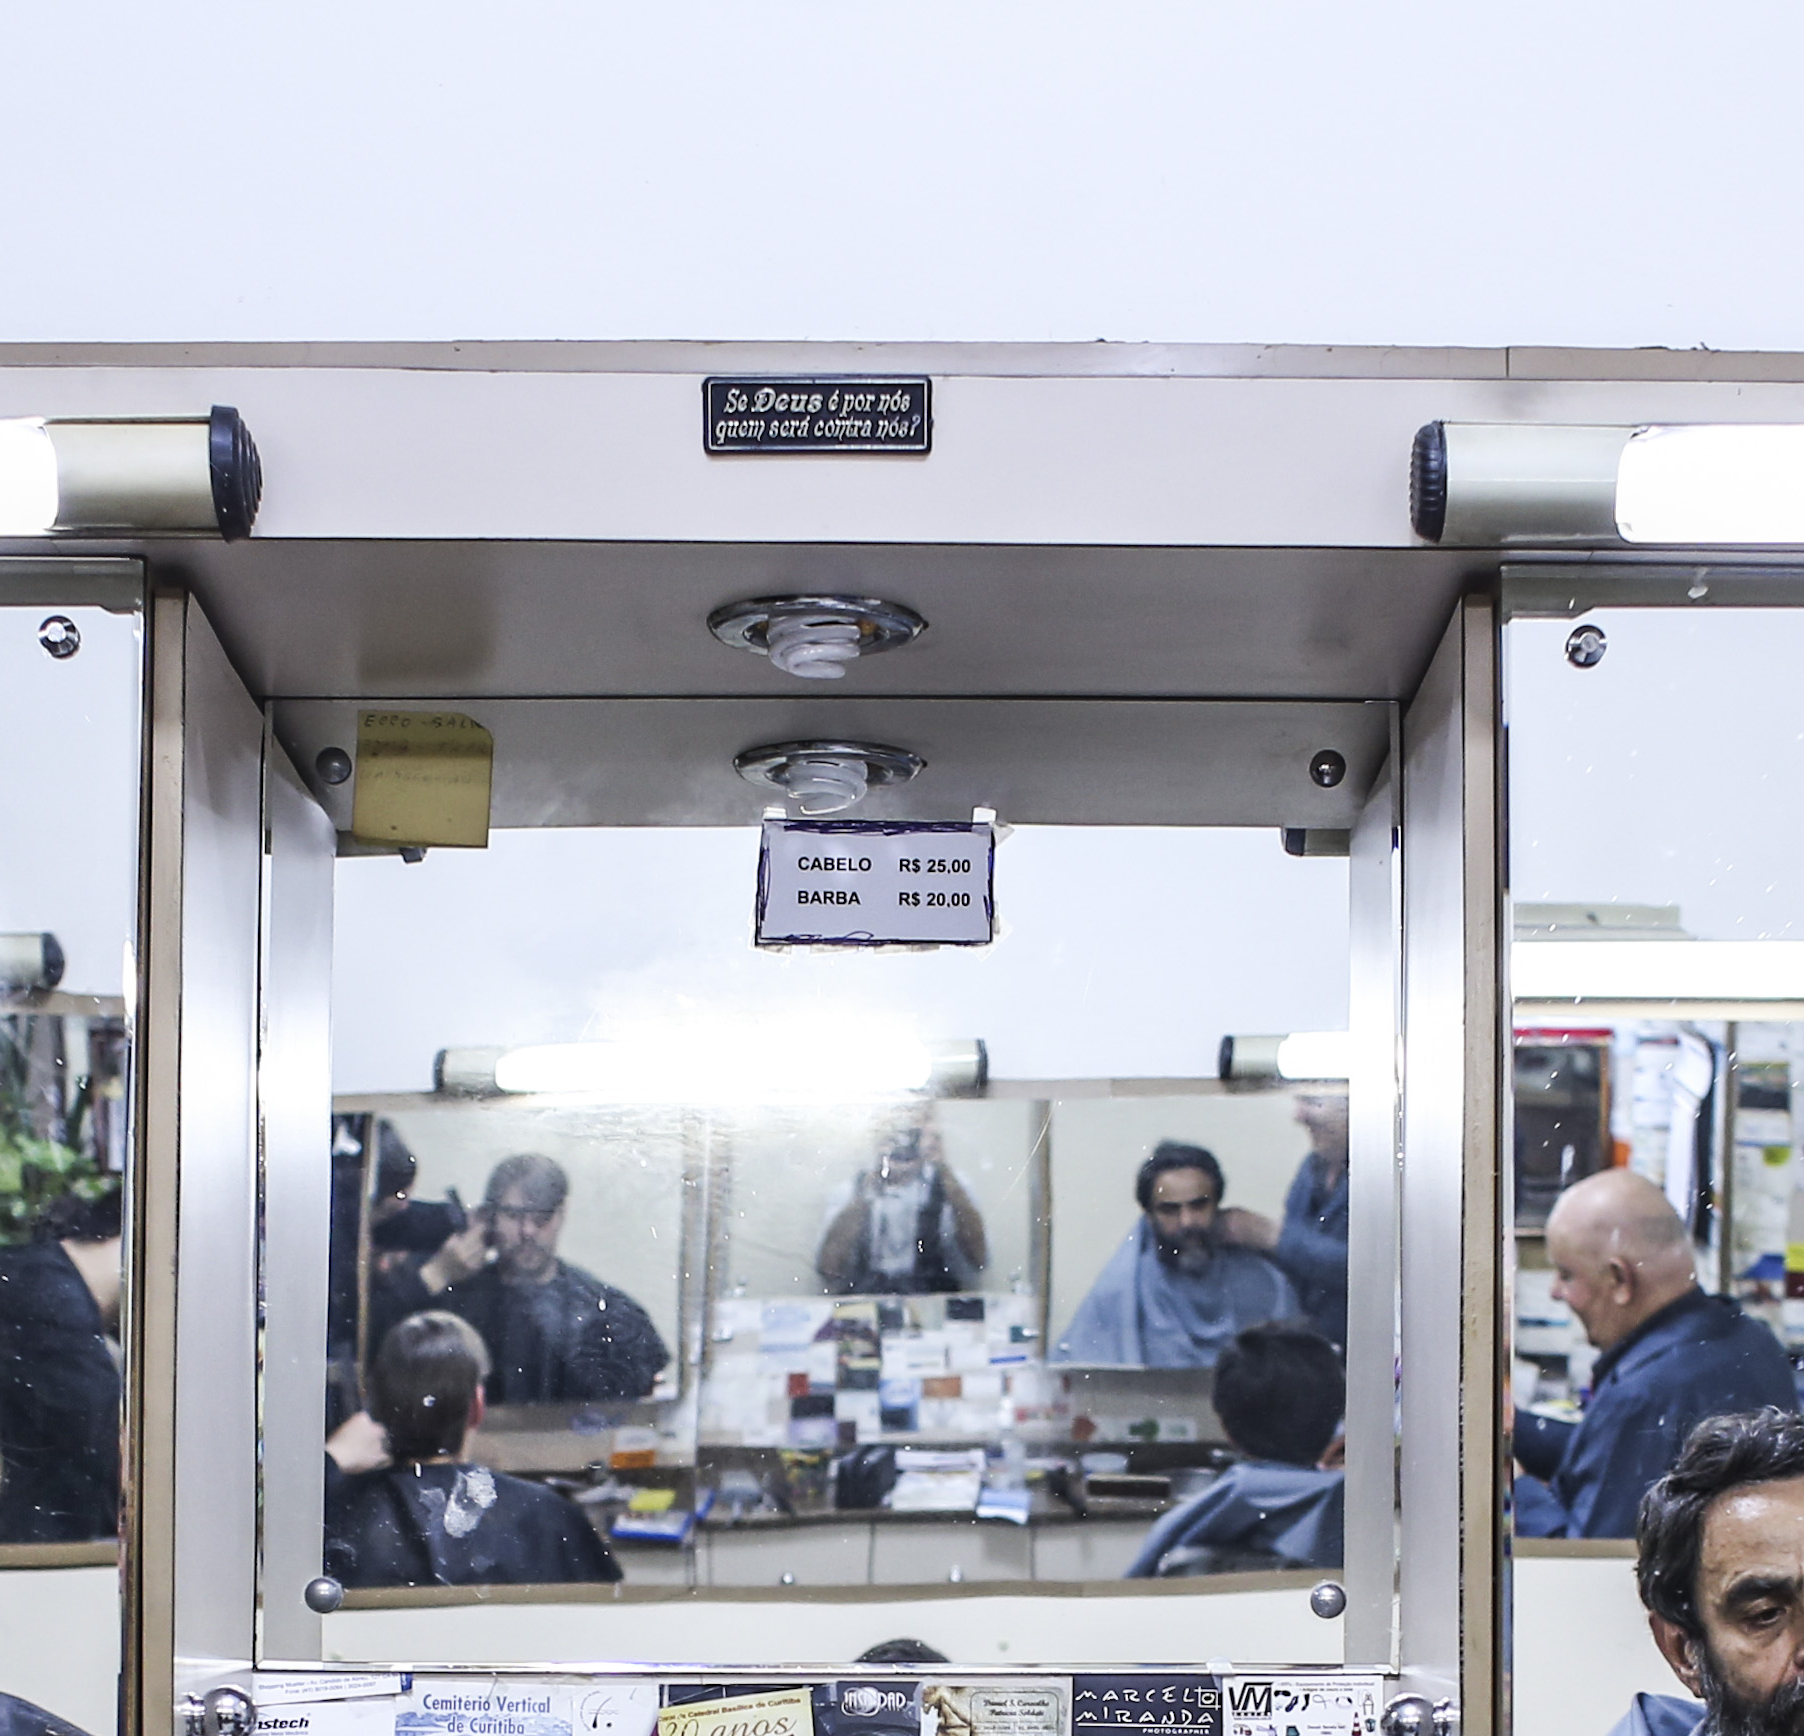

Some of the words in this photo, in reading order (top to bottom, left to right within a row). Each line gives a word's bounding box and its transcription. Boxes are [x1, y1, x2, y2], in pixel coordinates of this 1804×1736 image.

[724, 388, 748, 413] Se
[751, 387, 823, 413] Deus
[828, 390, 839, 412] é
[839, 394, 875, 417] por
[877, 390, 910, 415] nós
[716, 418, 765, 445] quem
[769, 415, 810, 438] será
[814, 416, 872, 441] contra
[875, 414, 921, 441] nós?
[797, 857, 872, 872] CABELO
[899, 858, 921, 874] R$
[926, 859, 971, 875] 25,00
[797, 890, 861, 905] BARBA
[898, 892, 921, 908] R$
[926, 893, 971, 908] 20,00
[423, 1693, 490, 1711] Cemitério
[496, 1696, 551, 1713] Vertical
[1075, 1685, 1217, 1705] MARCELO
[1228, 1682, 1274, 1716] VM
[447, 1716, 464, 1733] de
[470, 1718, 525, 1735] Curitiba
[1075, 1706, 1214, 1726] MIRANDA
